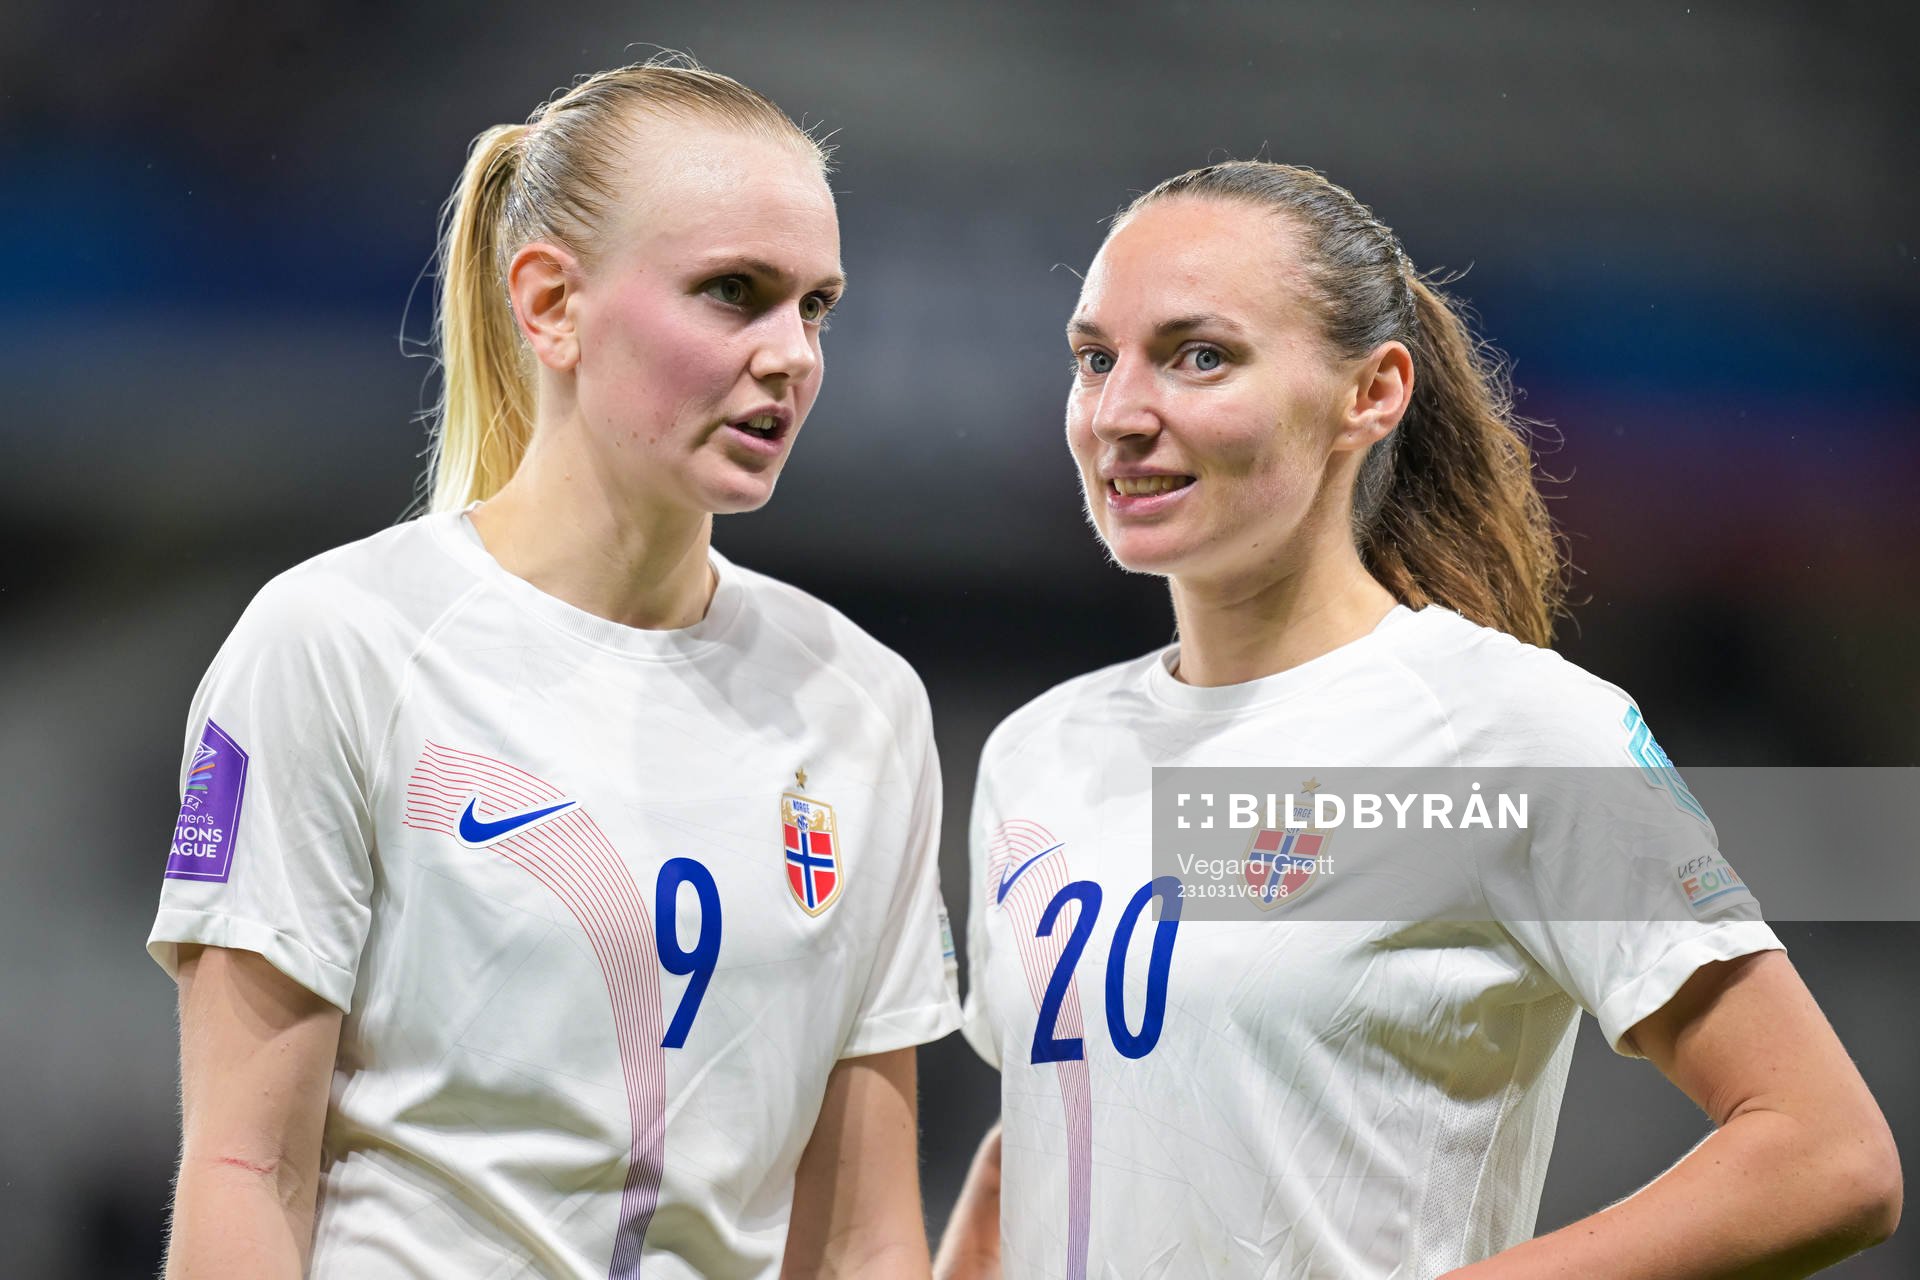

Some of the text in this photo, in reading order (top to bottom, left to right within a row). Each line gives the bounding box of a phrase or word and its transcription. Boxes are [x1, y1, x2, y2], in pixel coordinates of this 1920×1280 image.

[656, 857, 722, 1049] 9
[1677, 855, 1712, 879] UEFA
[1031, 875, 1183, 1064] 20
